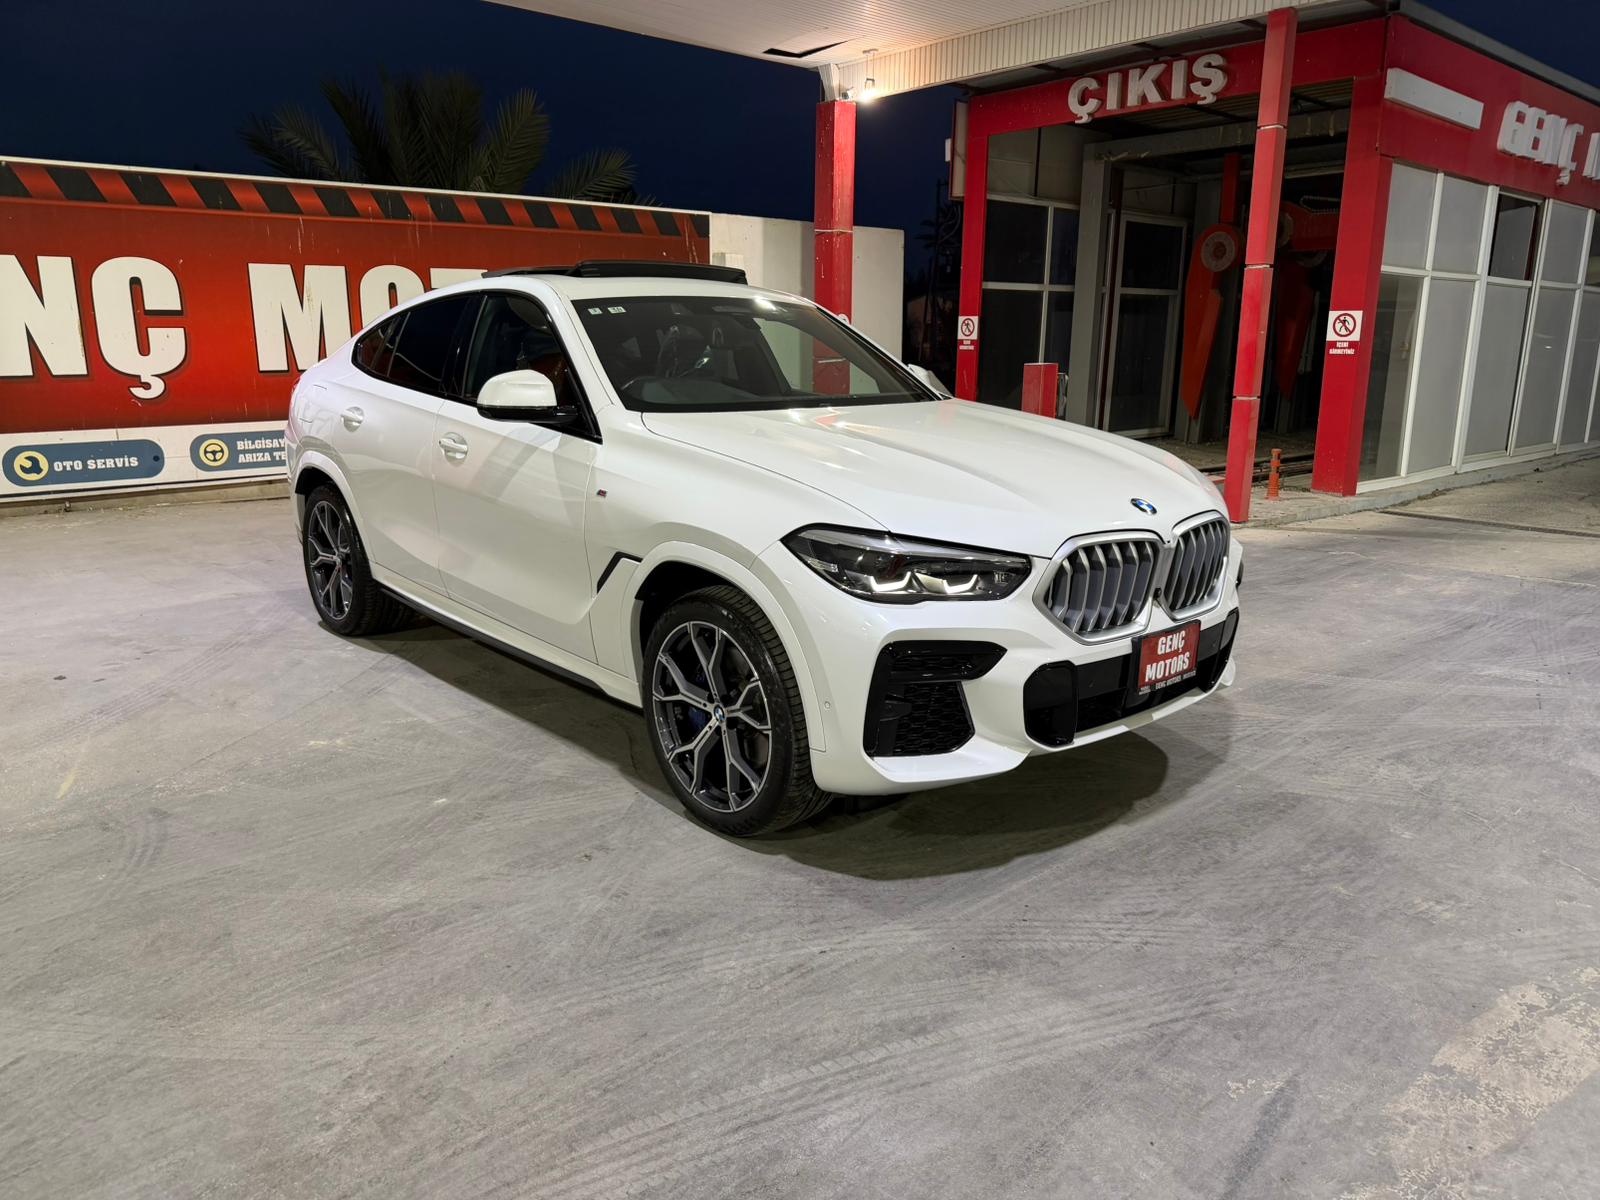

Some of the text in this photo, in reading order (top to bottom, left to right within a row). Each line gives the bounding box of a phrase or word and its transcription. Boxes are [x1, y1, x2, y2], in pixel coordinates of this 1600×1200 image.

[1068, 53, 1228, 124] ÇIKIŞ
[1497, 100, 1584, 185] GENÇ
[53, 454, 139, 472] OTO SERVİS
[238, 452, 272, 464] ARIZA
[1157, 630, 1186, 655] GENÇ
[1145, 651, 1190, 682] MOTORS
